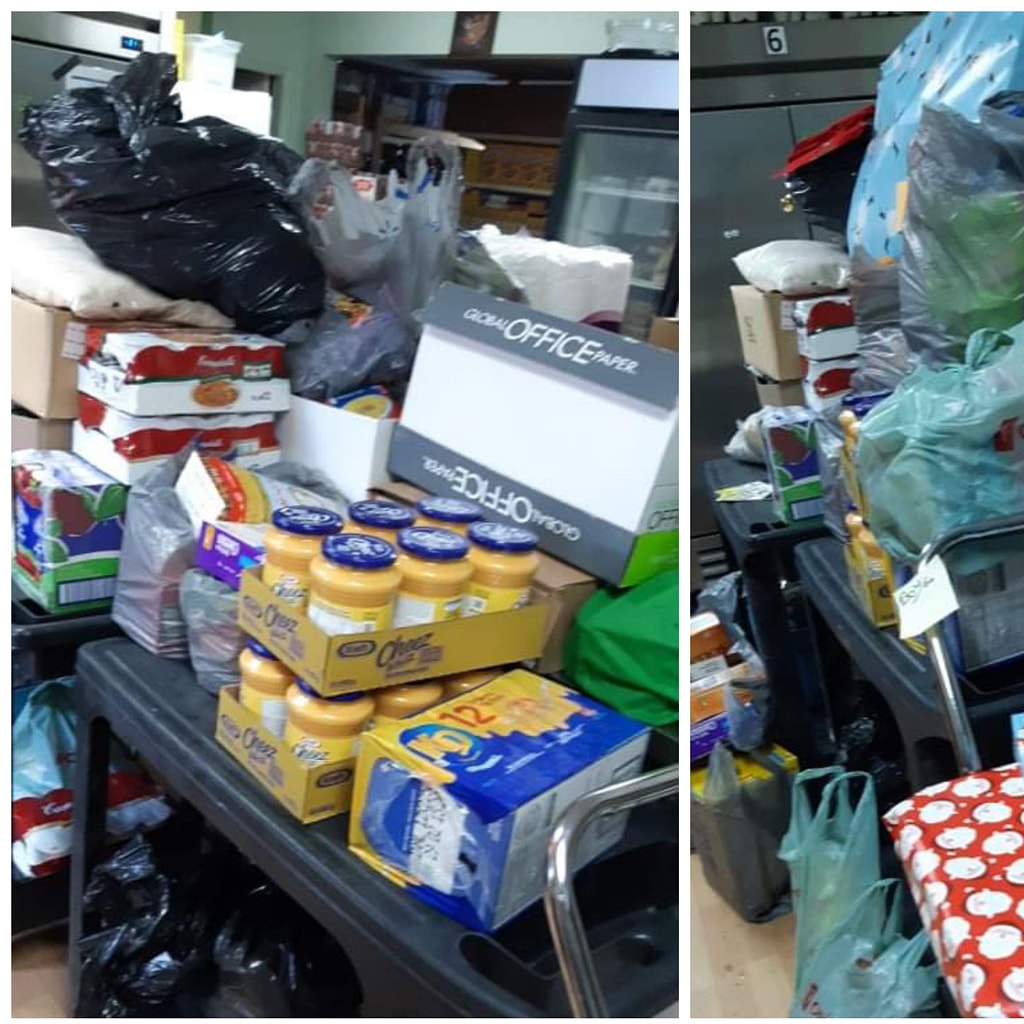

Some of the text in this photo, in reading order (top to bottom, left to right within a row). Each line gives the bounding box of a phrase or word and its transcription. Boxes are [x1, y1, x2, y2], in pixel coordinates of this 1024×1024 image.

[767, 28, 783, 53] 6
[462, 308, 508, 332] GLOBAL
[503, 318, 602, 365] OFFICE
[450, 466, 533, 524] OFFICE
[438, 704, 497, 728] 12
